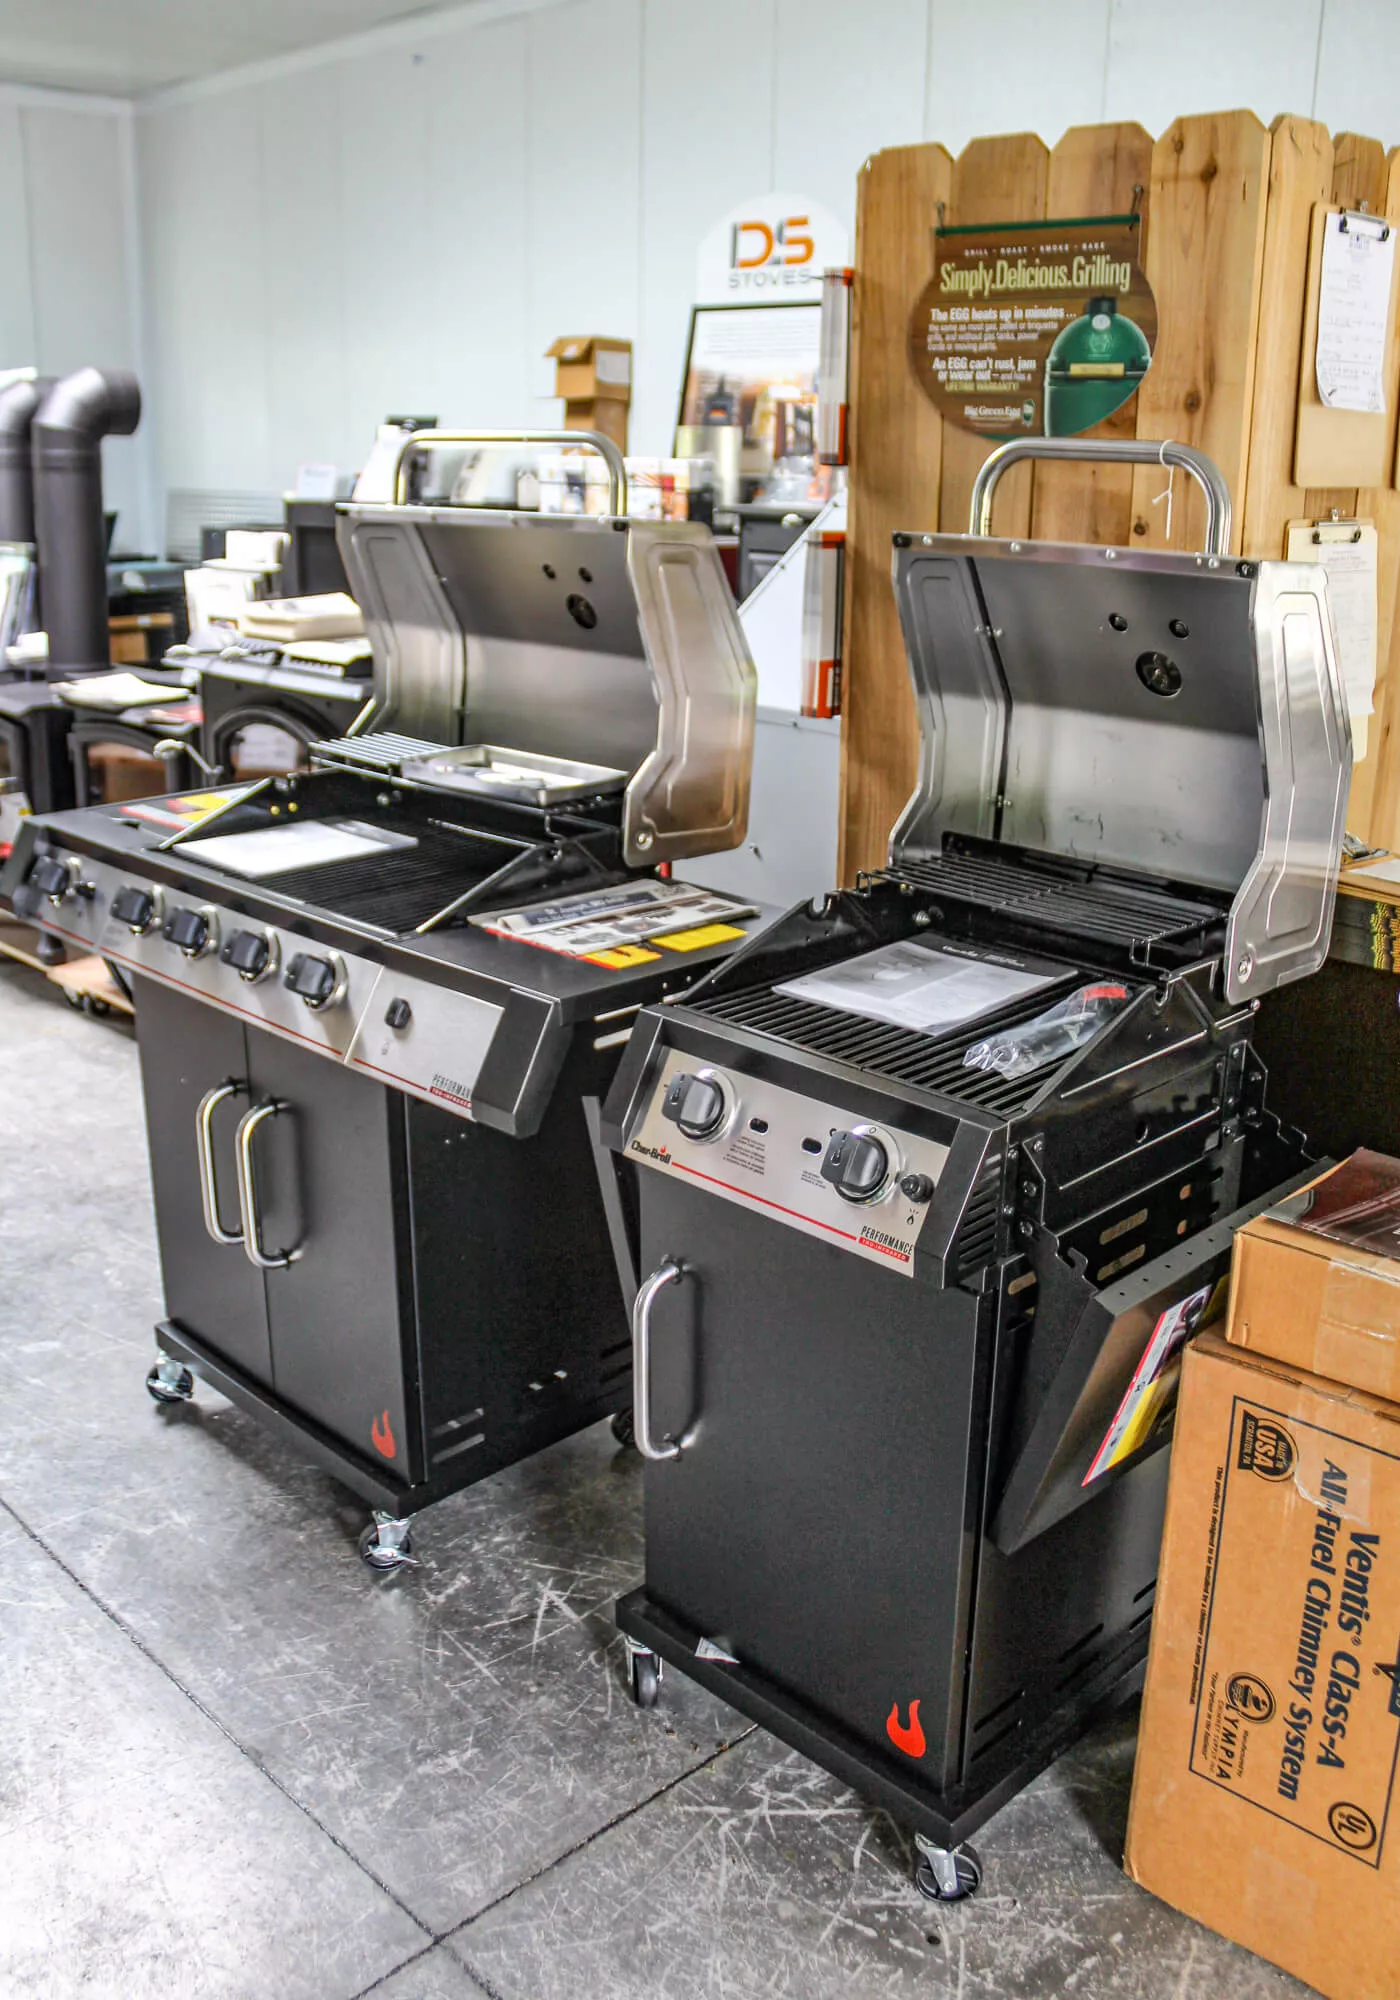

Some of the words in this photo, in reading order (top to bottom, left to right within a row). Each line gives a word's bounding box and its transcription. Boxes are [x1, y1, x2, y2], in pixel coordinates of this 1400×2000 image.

[728, 269, 813, 290] STOVES
[931, 308, 948, 321] The
[950, 307, 970, 321] EGG
[999, 309, 1012, 323] up
[1014, 305, 1023, 320] in
[932, 357, 946, 370] An
[948, 356, 968, 370] EGG
[1017, 356, 1037, 371] jam
[861, 1225, 913, 1256] PERFORMANCE
[1254, 1428, 1277, 1469] USA
[1310, 1457, 1348, 1576] All-Fuel
[1288, 1577, 1332, 1703] Chimney
[1316, 1650, 1361, 1769] Class-A
[1277, 1702, 1313, 1801] System
